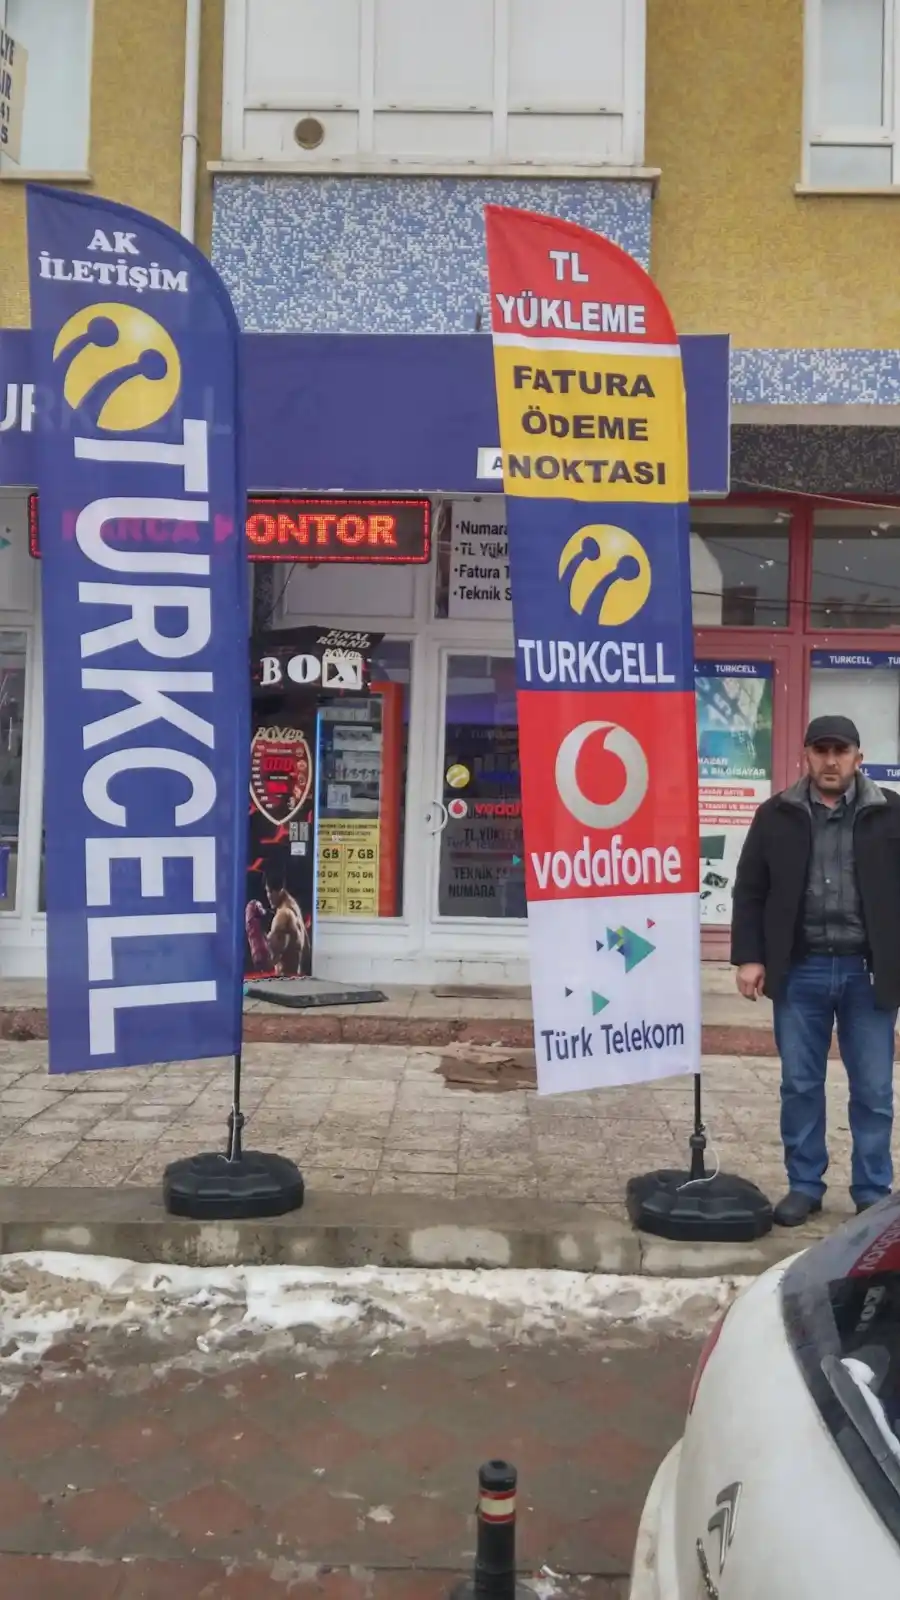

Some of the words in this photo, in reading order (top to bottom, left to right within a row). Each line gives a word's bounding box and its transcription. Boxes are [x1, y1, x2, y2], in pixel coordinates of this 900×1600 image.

[87, 229, 140, 255] AK
[38, 250, 189, 292] İLETİŞİM
[548, 250, 590, 283] TL
[496, 290, 646, 334] YÜKLEME
[513, 365, 656, 398] FATURA
[521, 405, 649, 441] ÖDEME
[508, 454, 666, 485] NOKTASI
[459, 564, 499, 579] Fatura
[458, 586, 501, 600] Teknik
[517, 638, 676, 684] TURKCELL
[714, 664, 757, 674] TURKCELL
[829, 655, 872, 665] TURKCELL
[74, 418, 217, 1056] TURKCELL
[347, 848, 355, 859] 7
[357, 848, 374, 860] GB
[531, 834, 683, 889] vodafone
[348, 899, 362, 910] 32
[541, 1026, 593, 1061] Türk
[601, 1019, 684, 1055] Telekom
